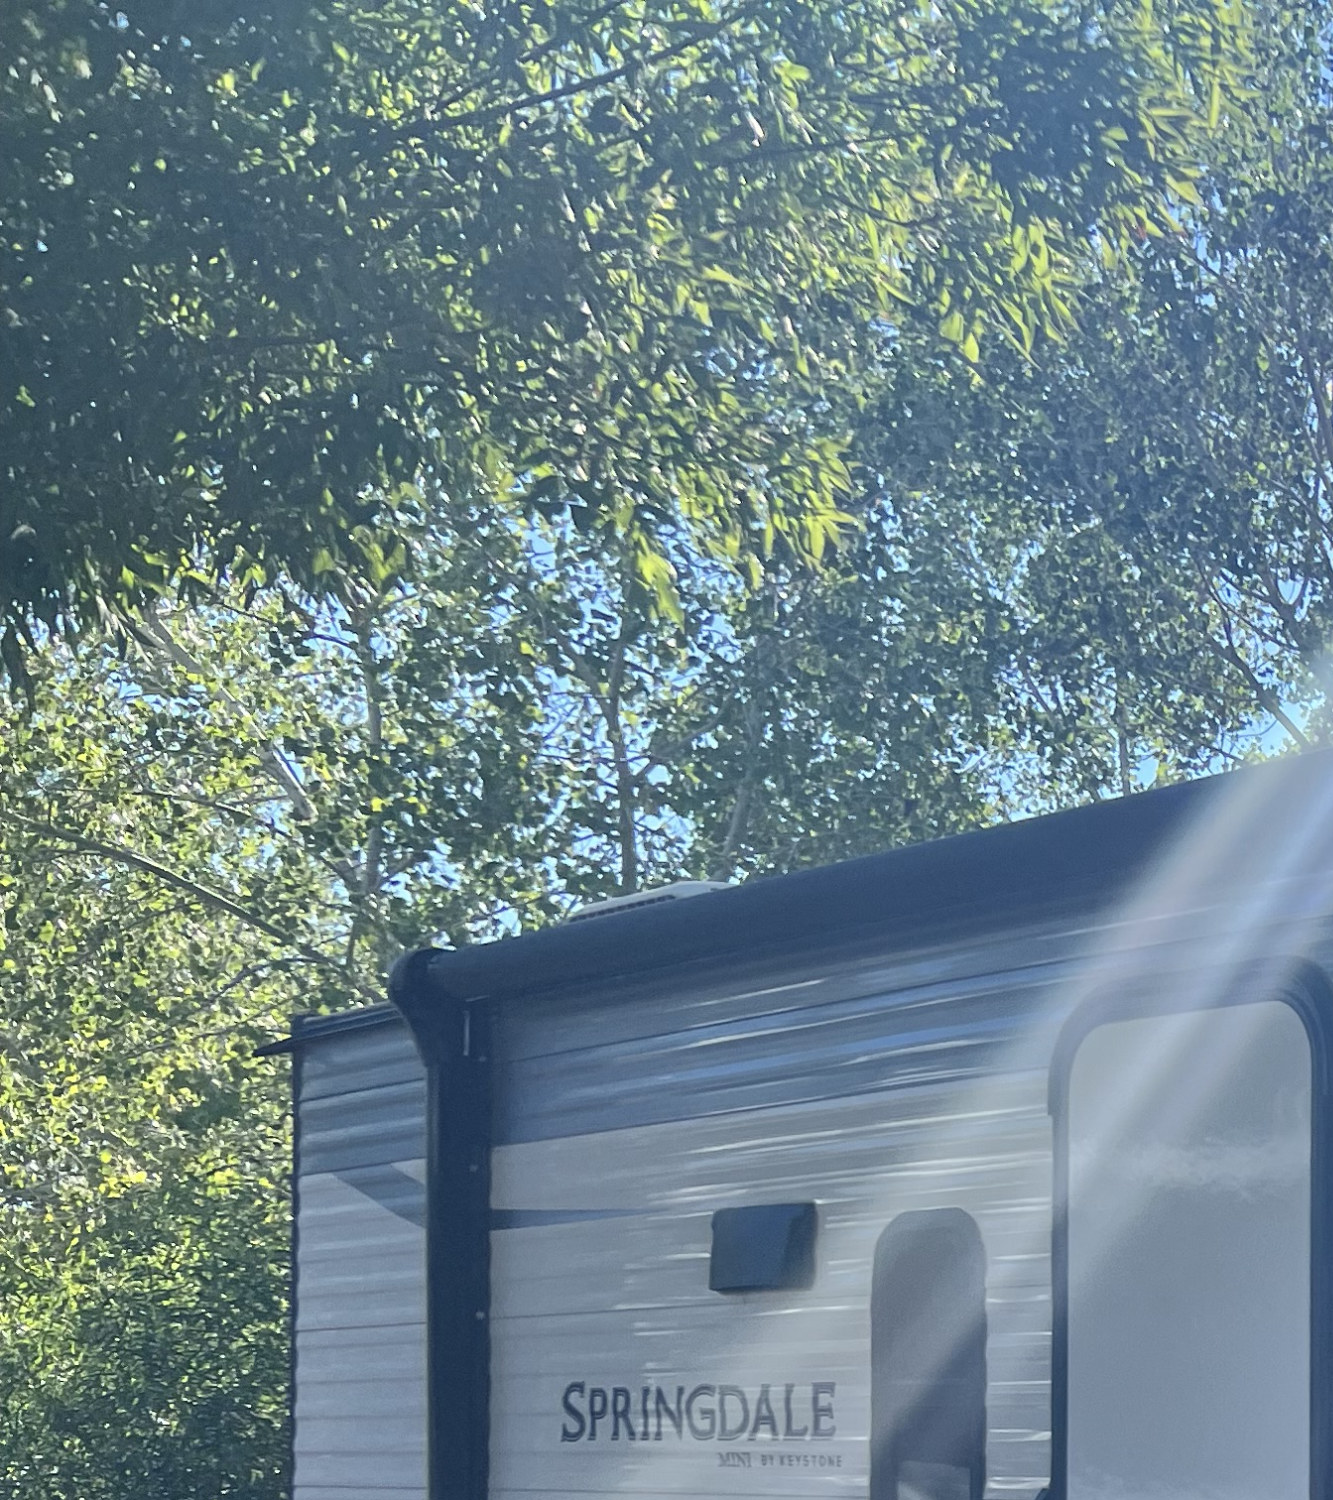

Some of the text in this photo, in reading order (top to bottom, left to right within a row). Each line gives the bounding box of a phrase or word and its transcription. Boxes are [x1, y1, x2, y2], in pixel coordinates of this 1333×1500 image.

[560, 1381, 837, 1442] SPRINGDALE
[761, 1454, 775, 1467] BY
[779, 1454, 843, 1468] KEYSTONE
